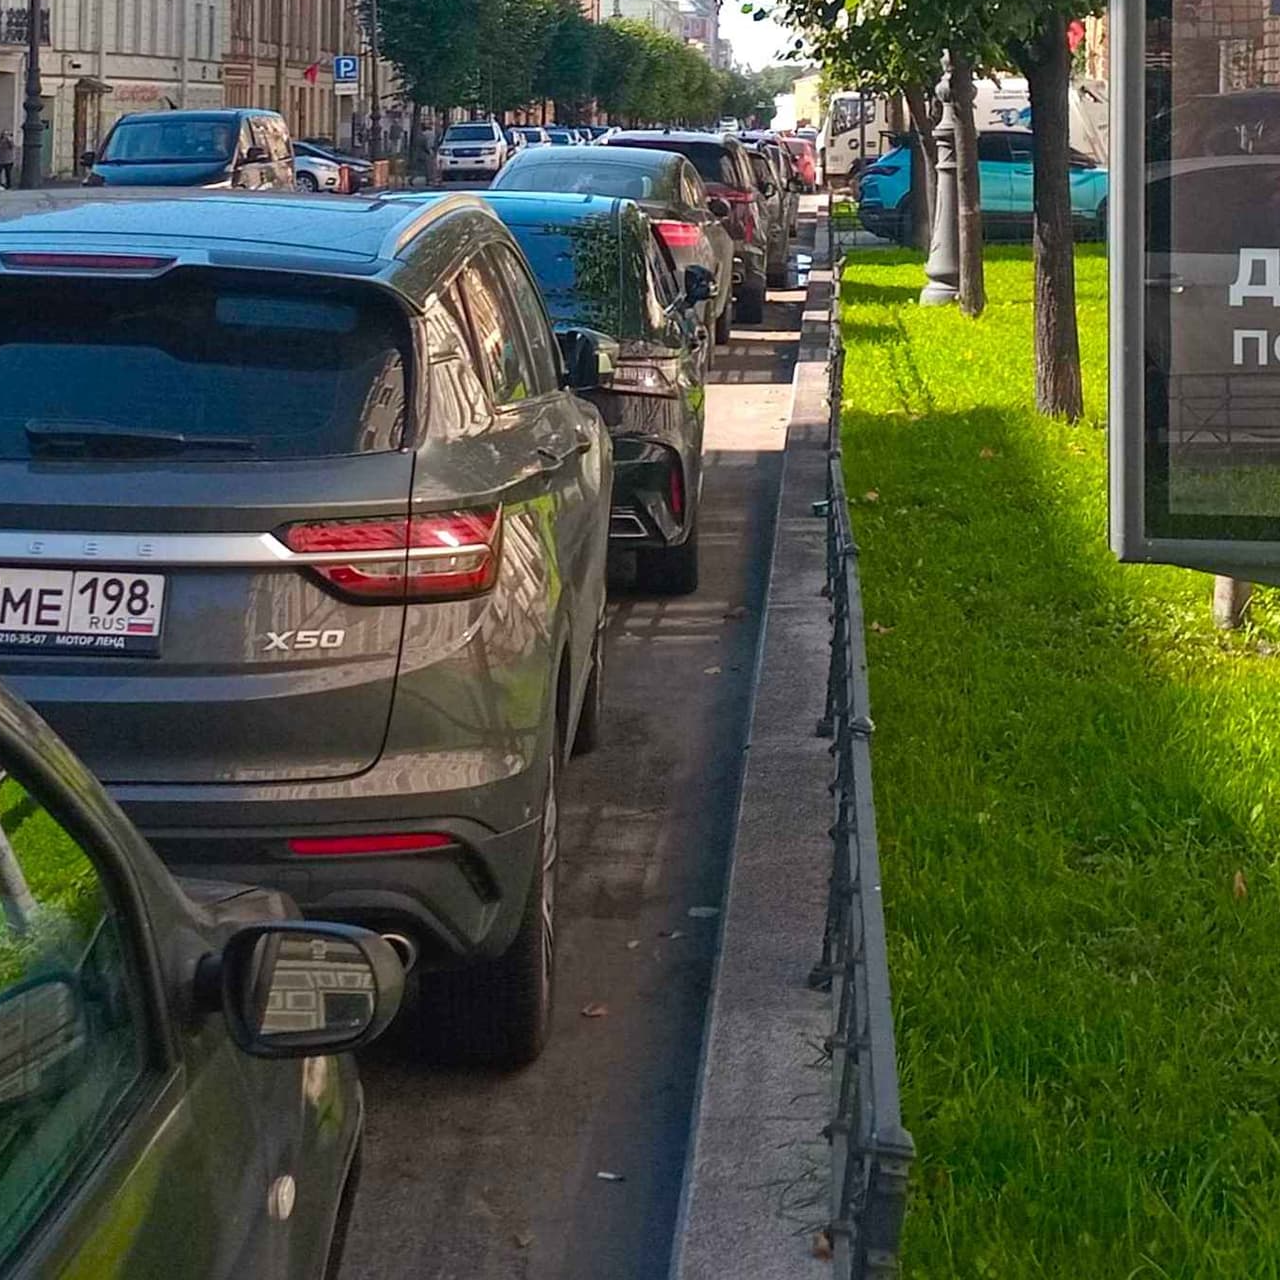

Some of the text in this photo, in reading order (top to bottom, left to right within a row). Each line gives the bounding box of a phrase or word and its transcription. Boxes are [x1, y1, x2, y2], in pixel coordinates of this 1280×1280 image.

[78, 576, 150, 616] 198
[88, 615, 125, 631] RUS
[55, 634, 93, 645] МОТОР
[95, 636, 125, 648] ЛЕНД
[262, 629, 345, 651] X50
